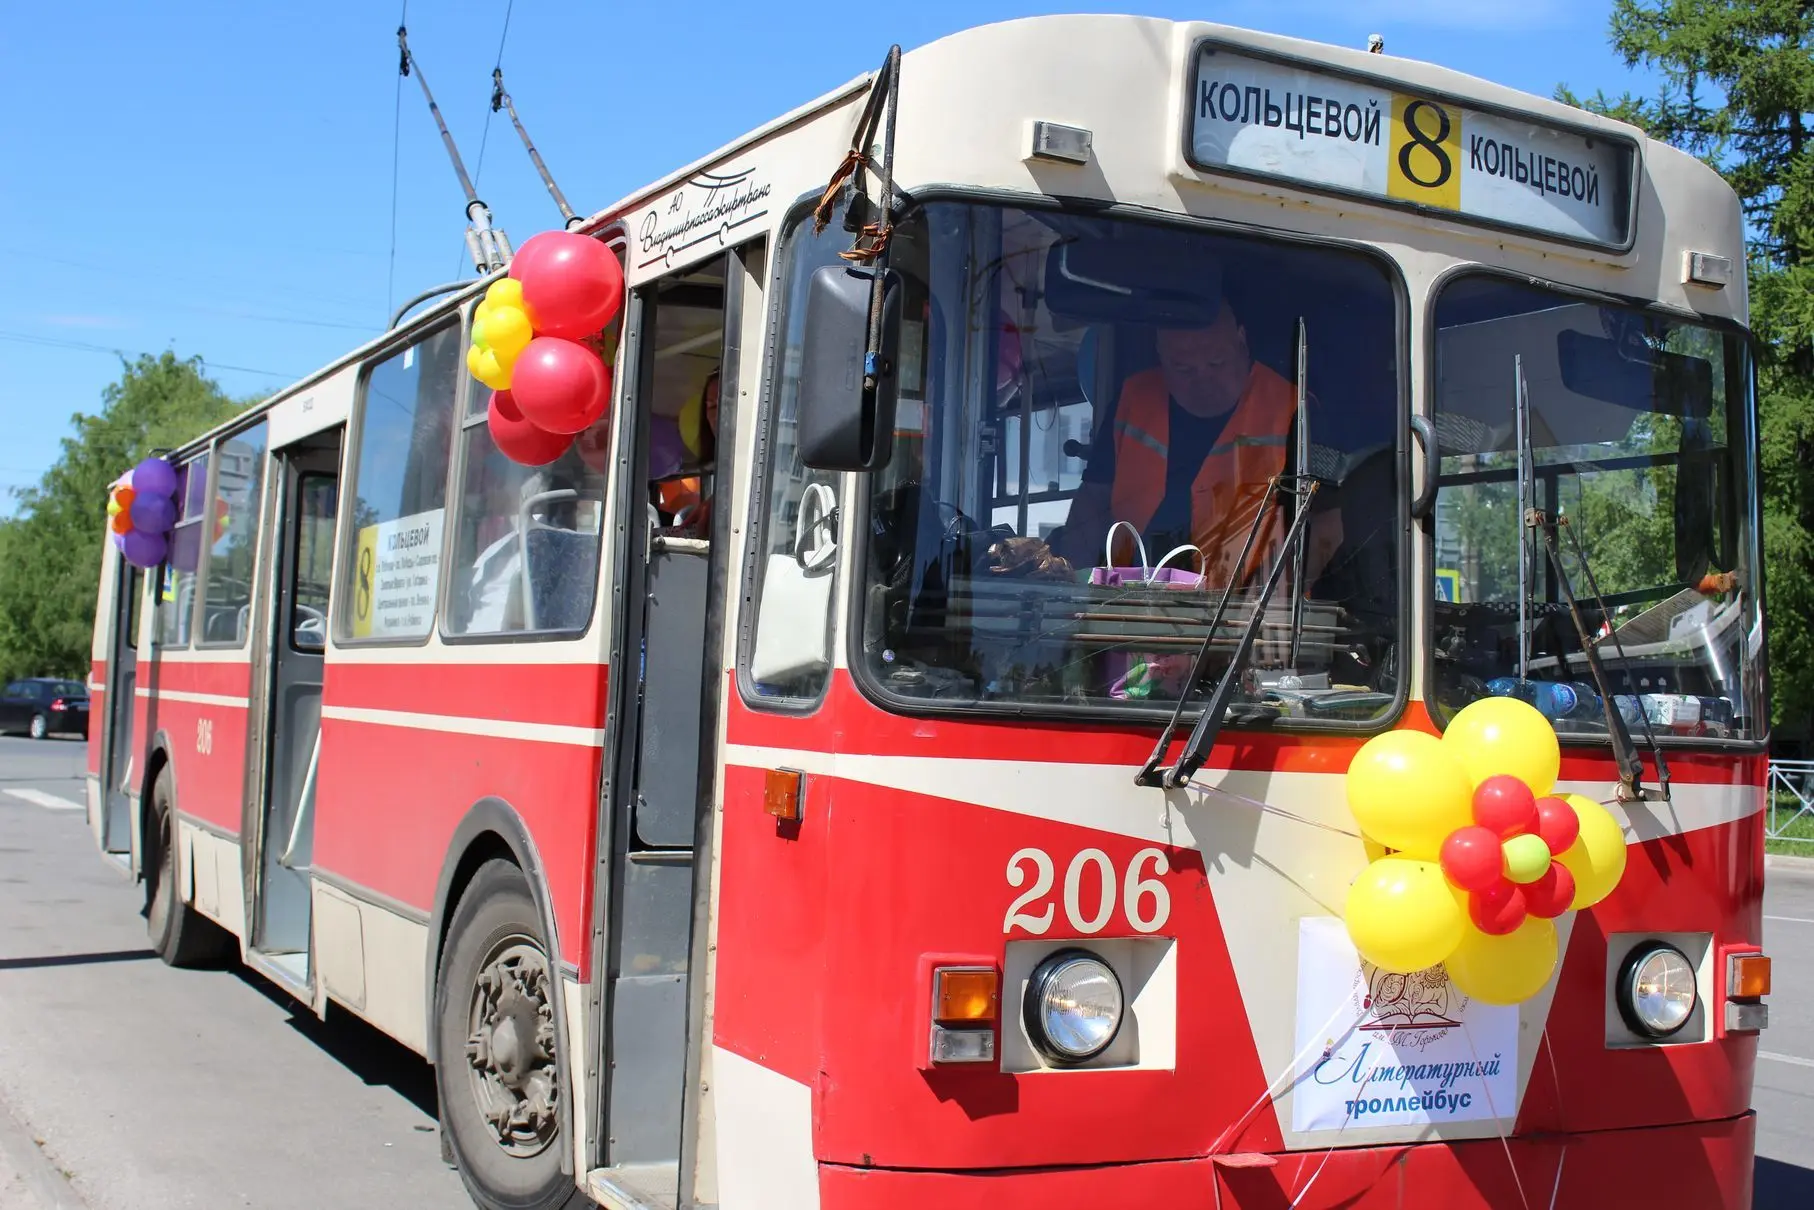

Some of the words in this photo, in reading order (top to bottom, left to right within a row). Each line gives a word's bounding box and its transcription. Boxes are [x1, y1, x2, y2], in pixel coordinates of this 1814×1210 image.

[1200, 79, 1381, 146] КОЛЬЦЕВОЙ
[1398, 100, 1452, 188] 8
[1471, 133, 1600, 206] КОЛЬЦЕВОЙ
[668, 192, 683, 215] АО
[357, 546, 371, 621] 8
[1003, 848, 1171, 935] 206
[1314, 1042, 1501, 1090] Литературный
[1345, 1090, 1472, 1119] троллейбус
